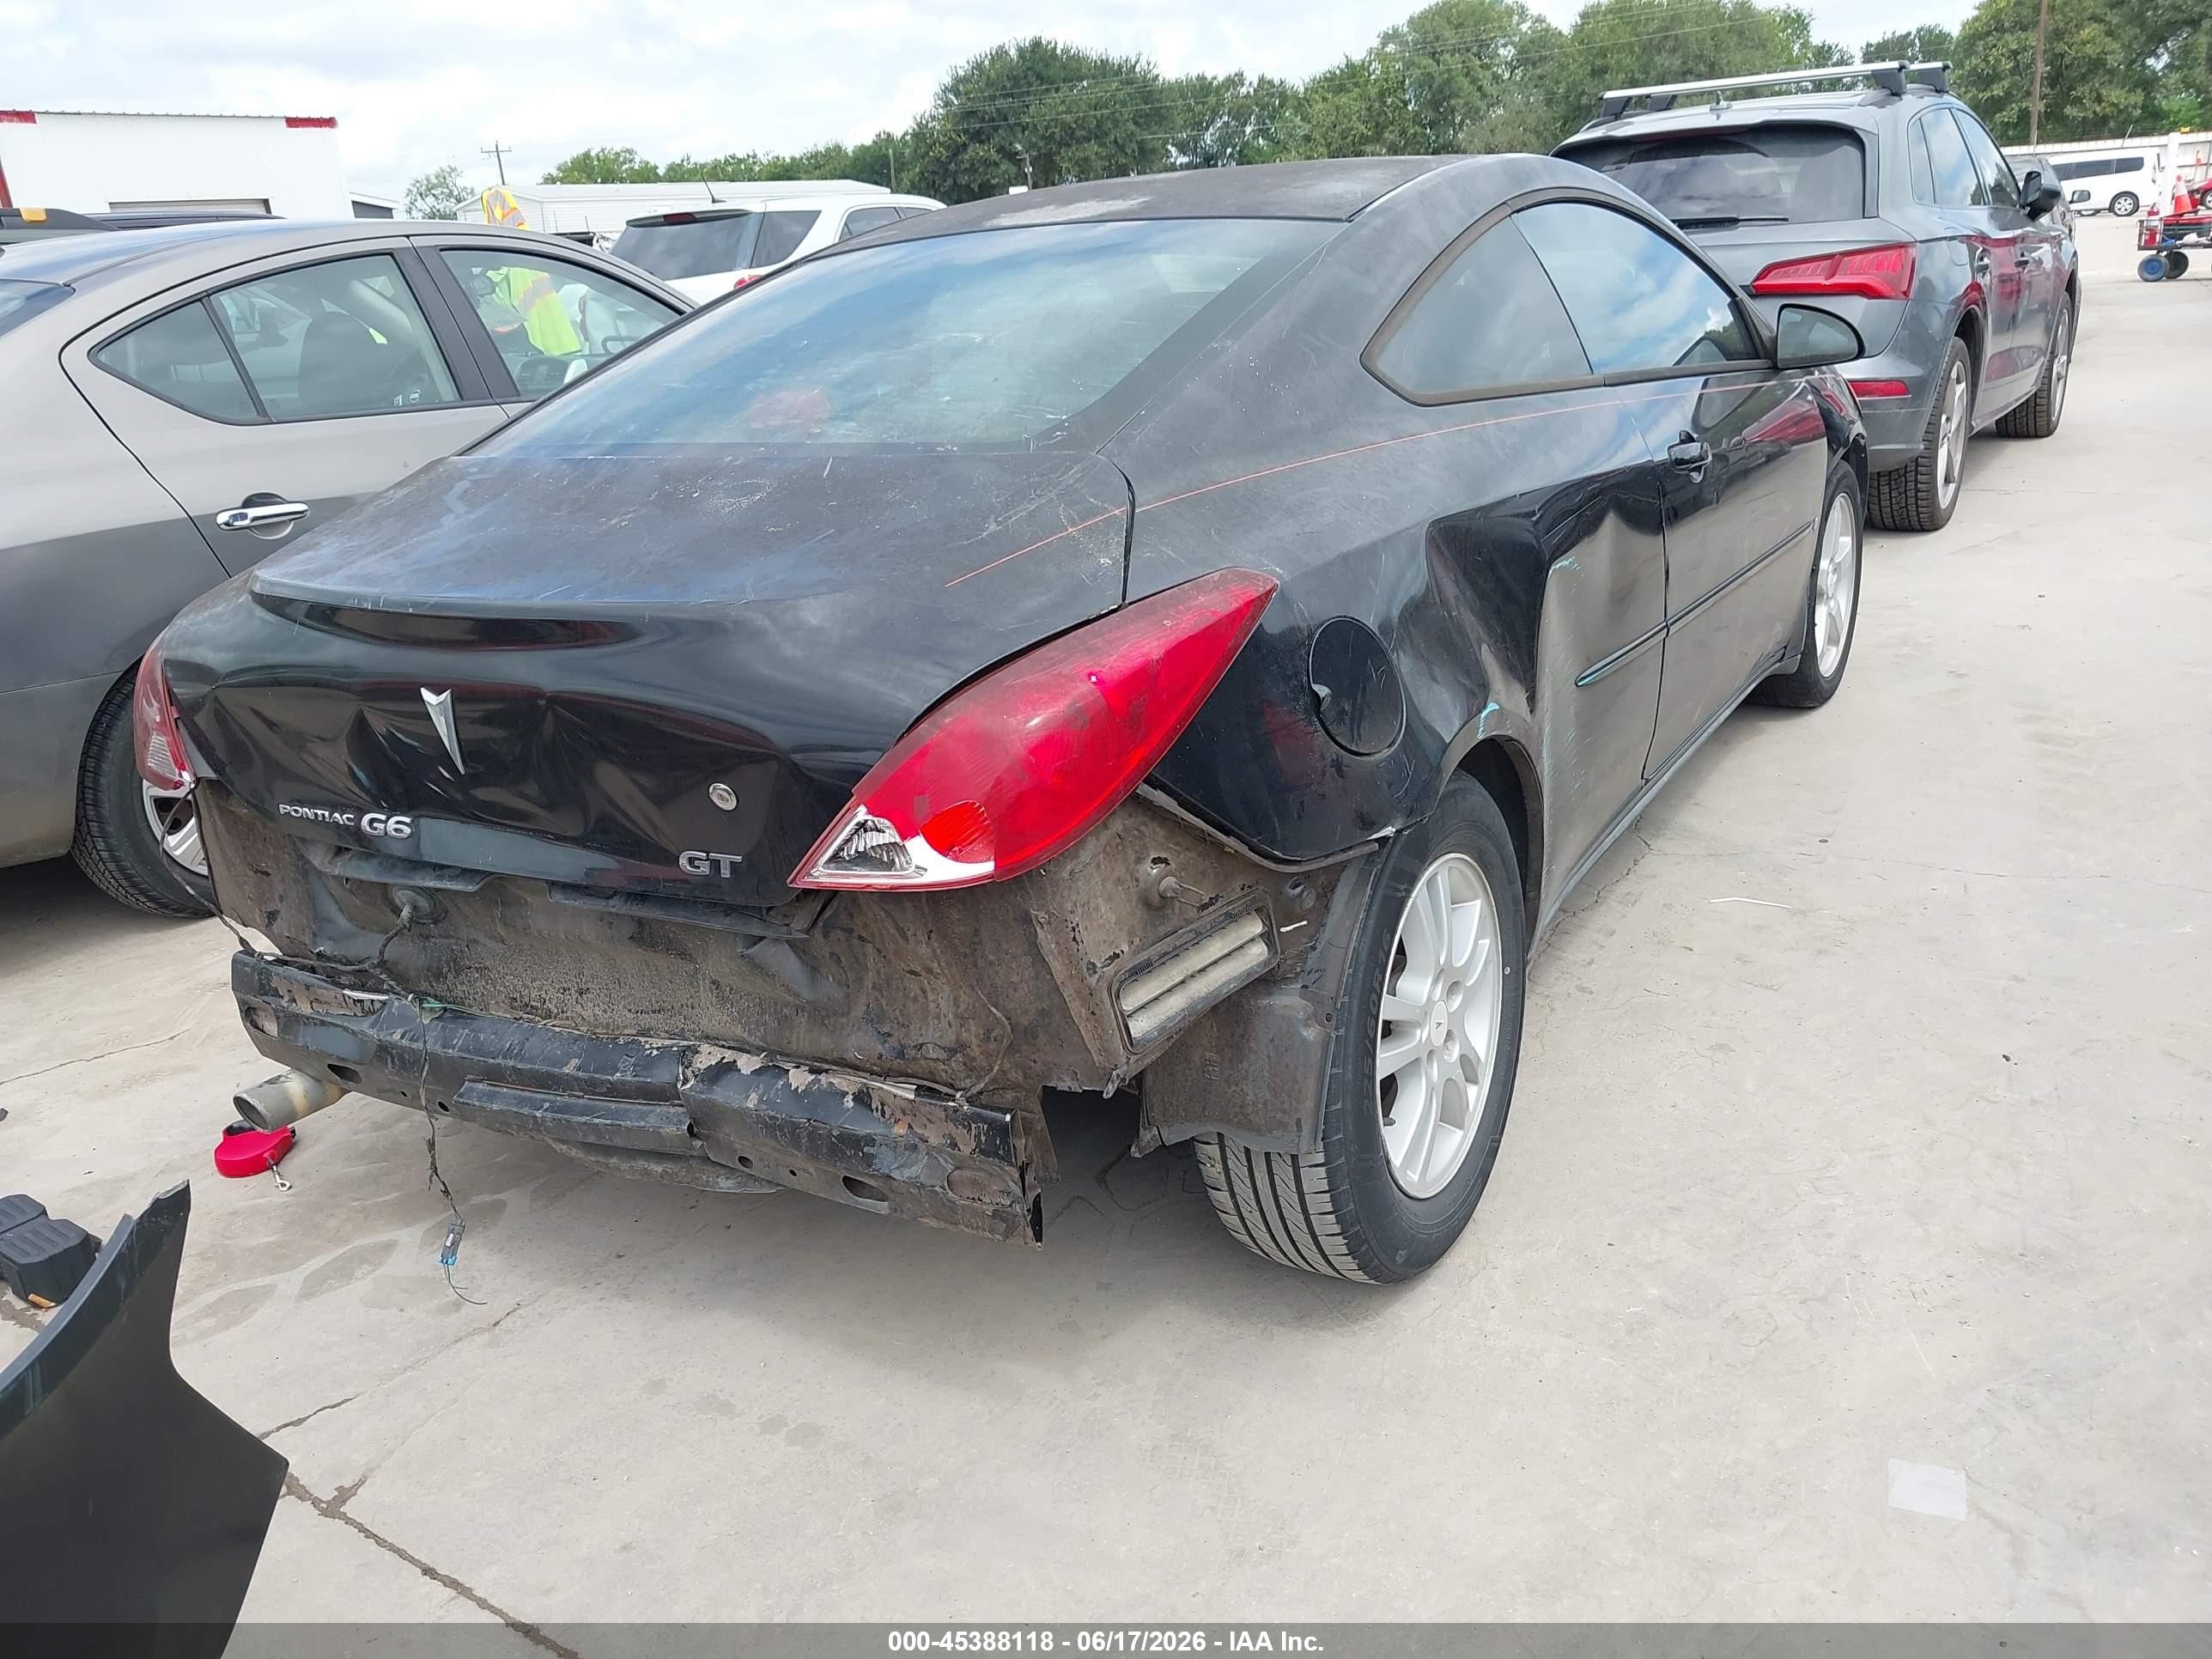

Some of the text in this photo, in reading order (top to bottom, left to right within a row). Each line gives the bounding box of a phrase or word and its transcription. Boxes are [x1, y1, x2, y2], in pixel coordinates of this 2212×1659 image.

[278, 804, 412, 839] PONTIAC G6
[678, 850, 743, 878] GT
